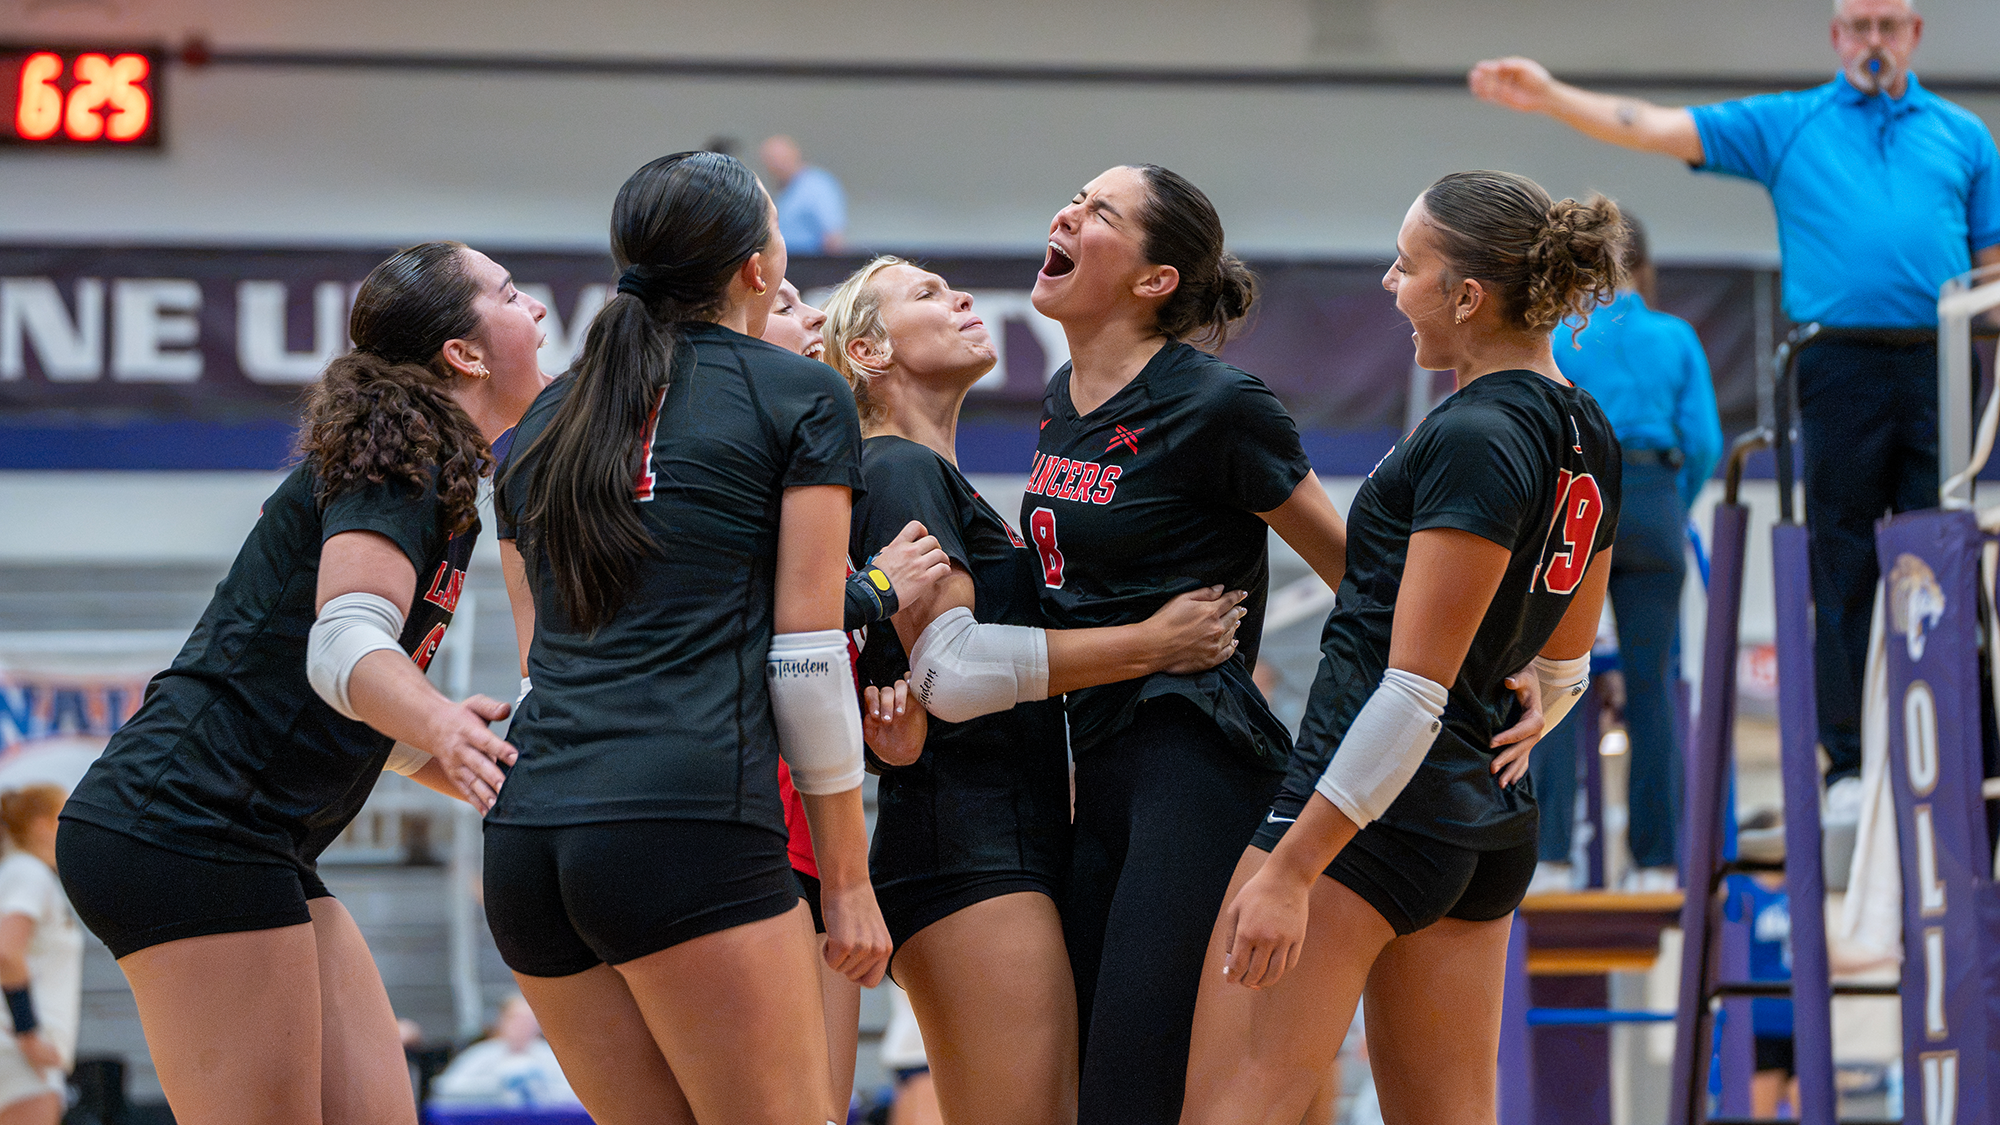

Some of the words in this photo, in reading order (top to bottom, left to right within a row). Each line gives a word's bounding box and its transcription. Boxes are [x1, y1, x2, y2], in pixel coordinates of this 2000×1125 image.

[1029, 506, 1066, 590] 8
[766, 658, 829, 679] Tandem
[919, 667, 938, 708] ndem
